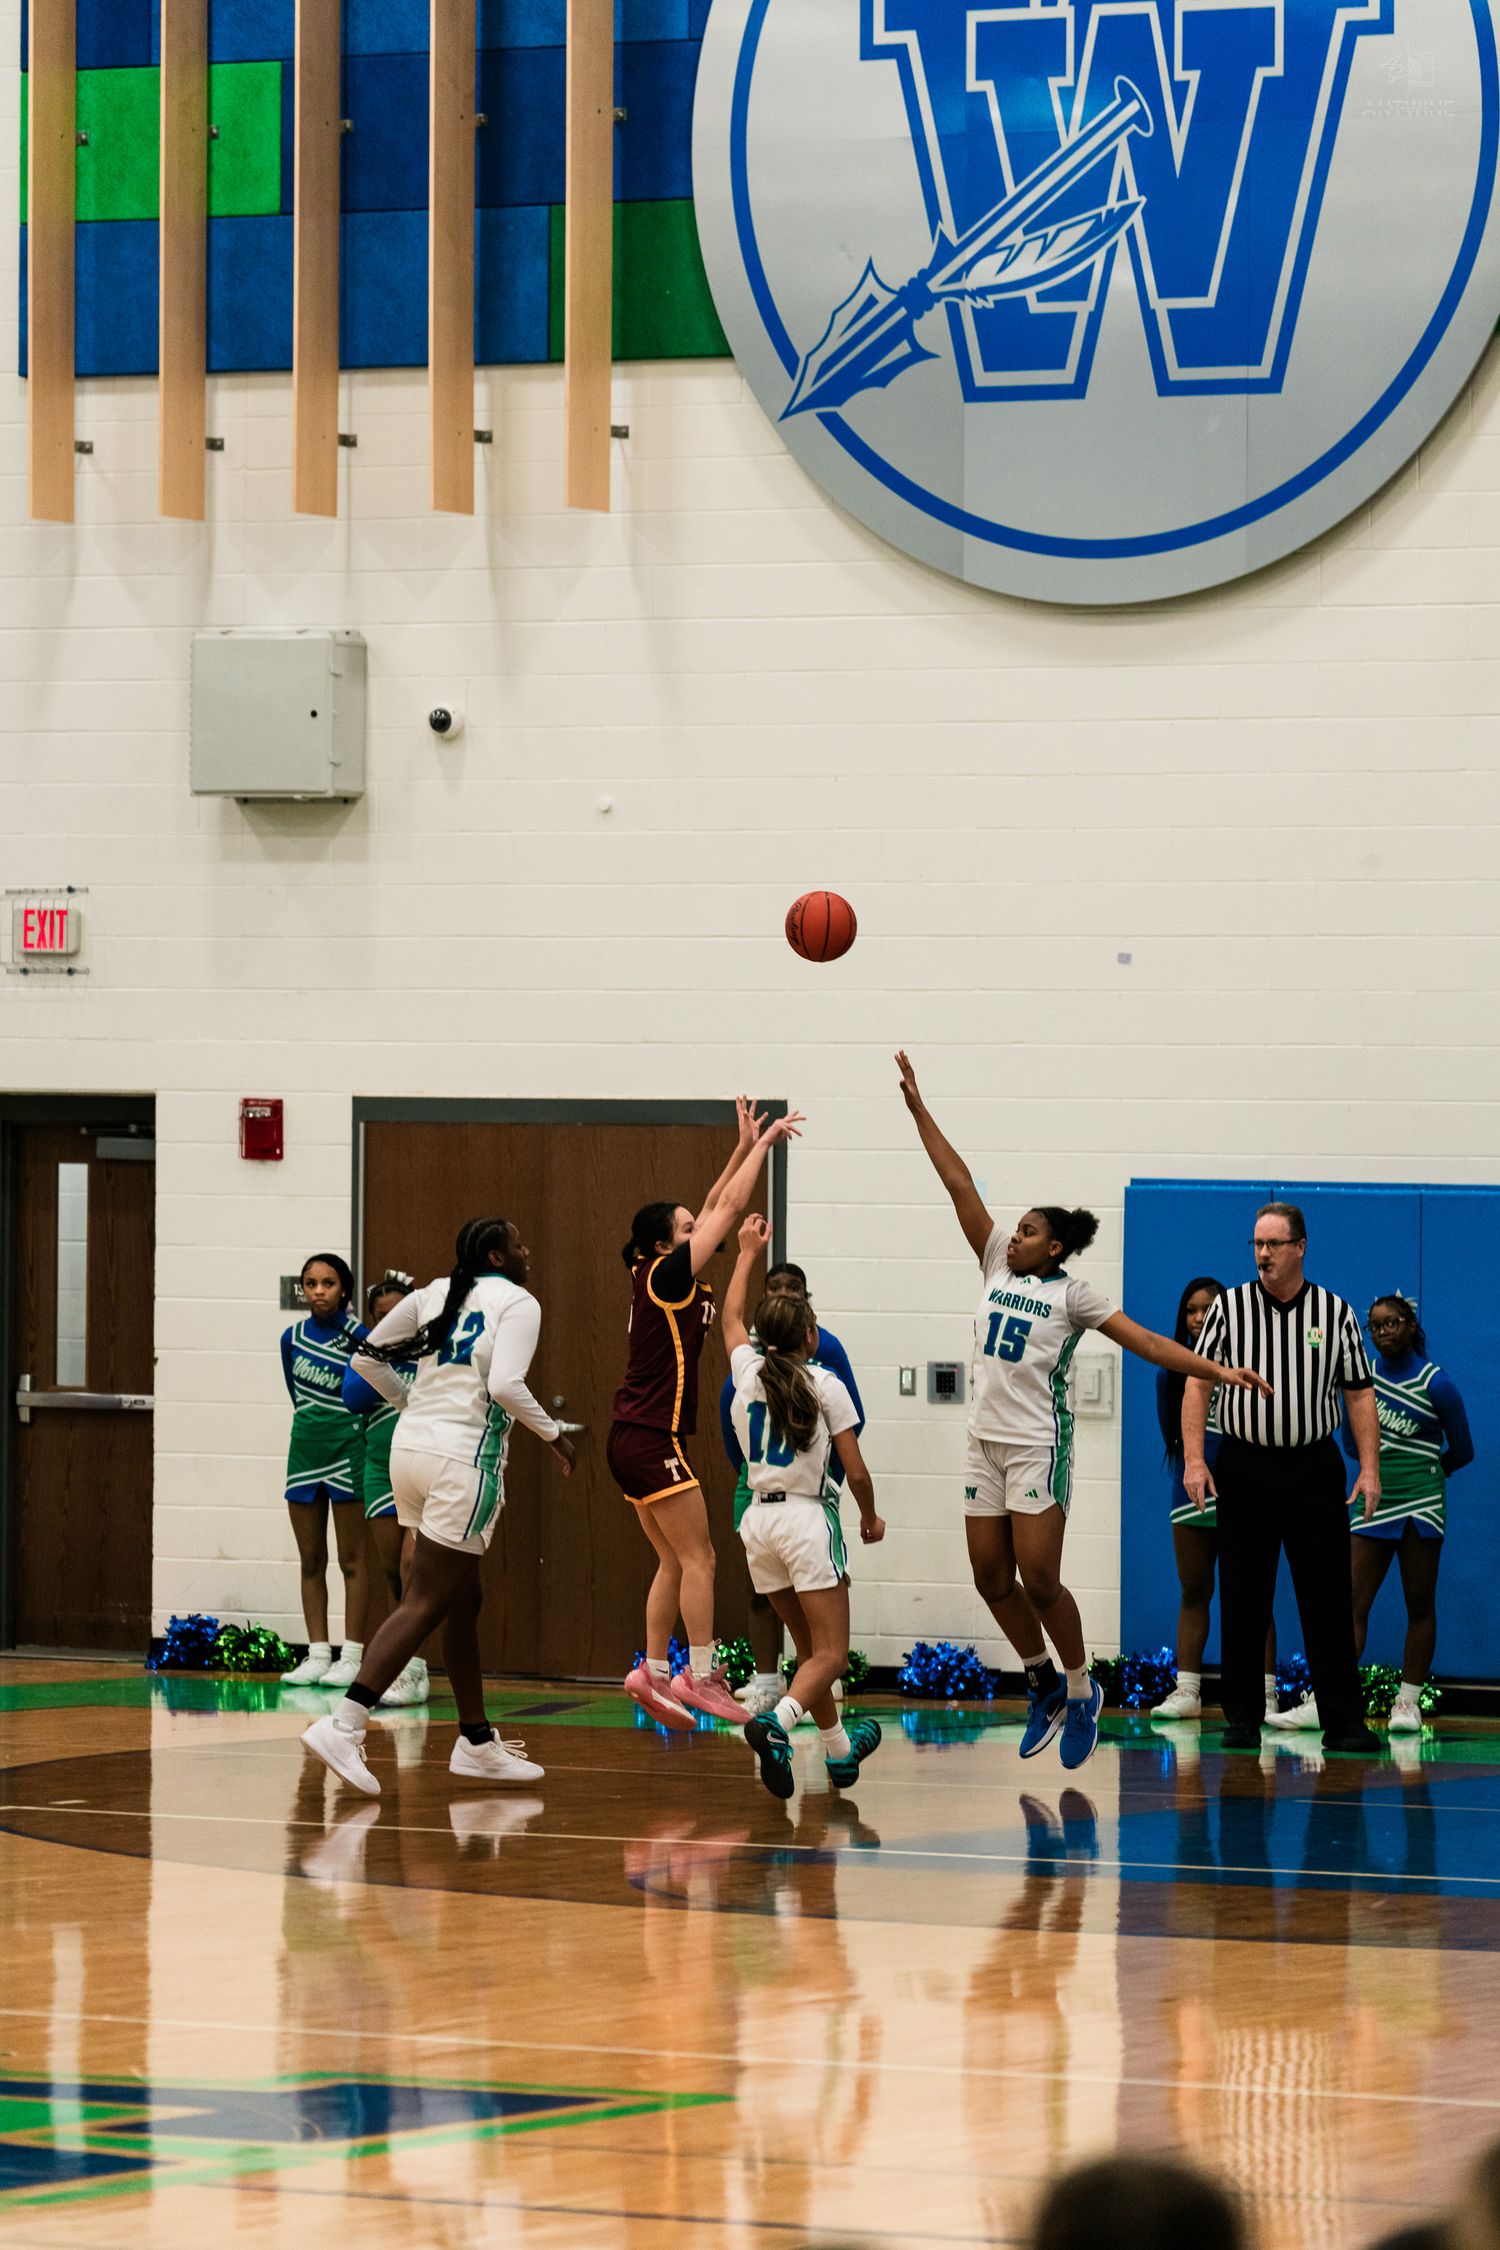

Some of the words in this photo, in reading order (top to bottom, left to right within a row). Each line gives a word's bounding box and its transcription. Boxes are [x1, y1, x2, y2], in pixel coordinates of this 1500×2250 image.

[23, 908, 68, 950] EXIT
[988, 1287, 1052, 1318] WARRIORS
[983, 1311, 1033, 1364] 15
[292, 1354, 342, 1389] Warriors
[663, 1457, 681, 1482] T
